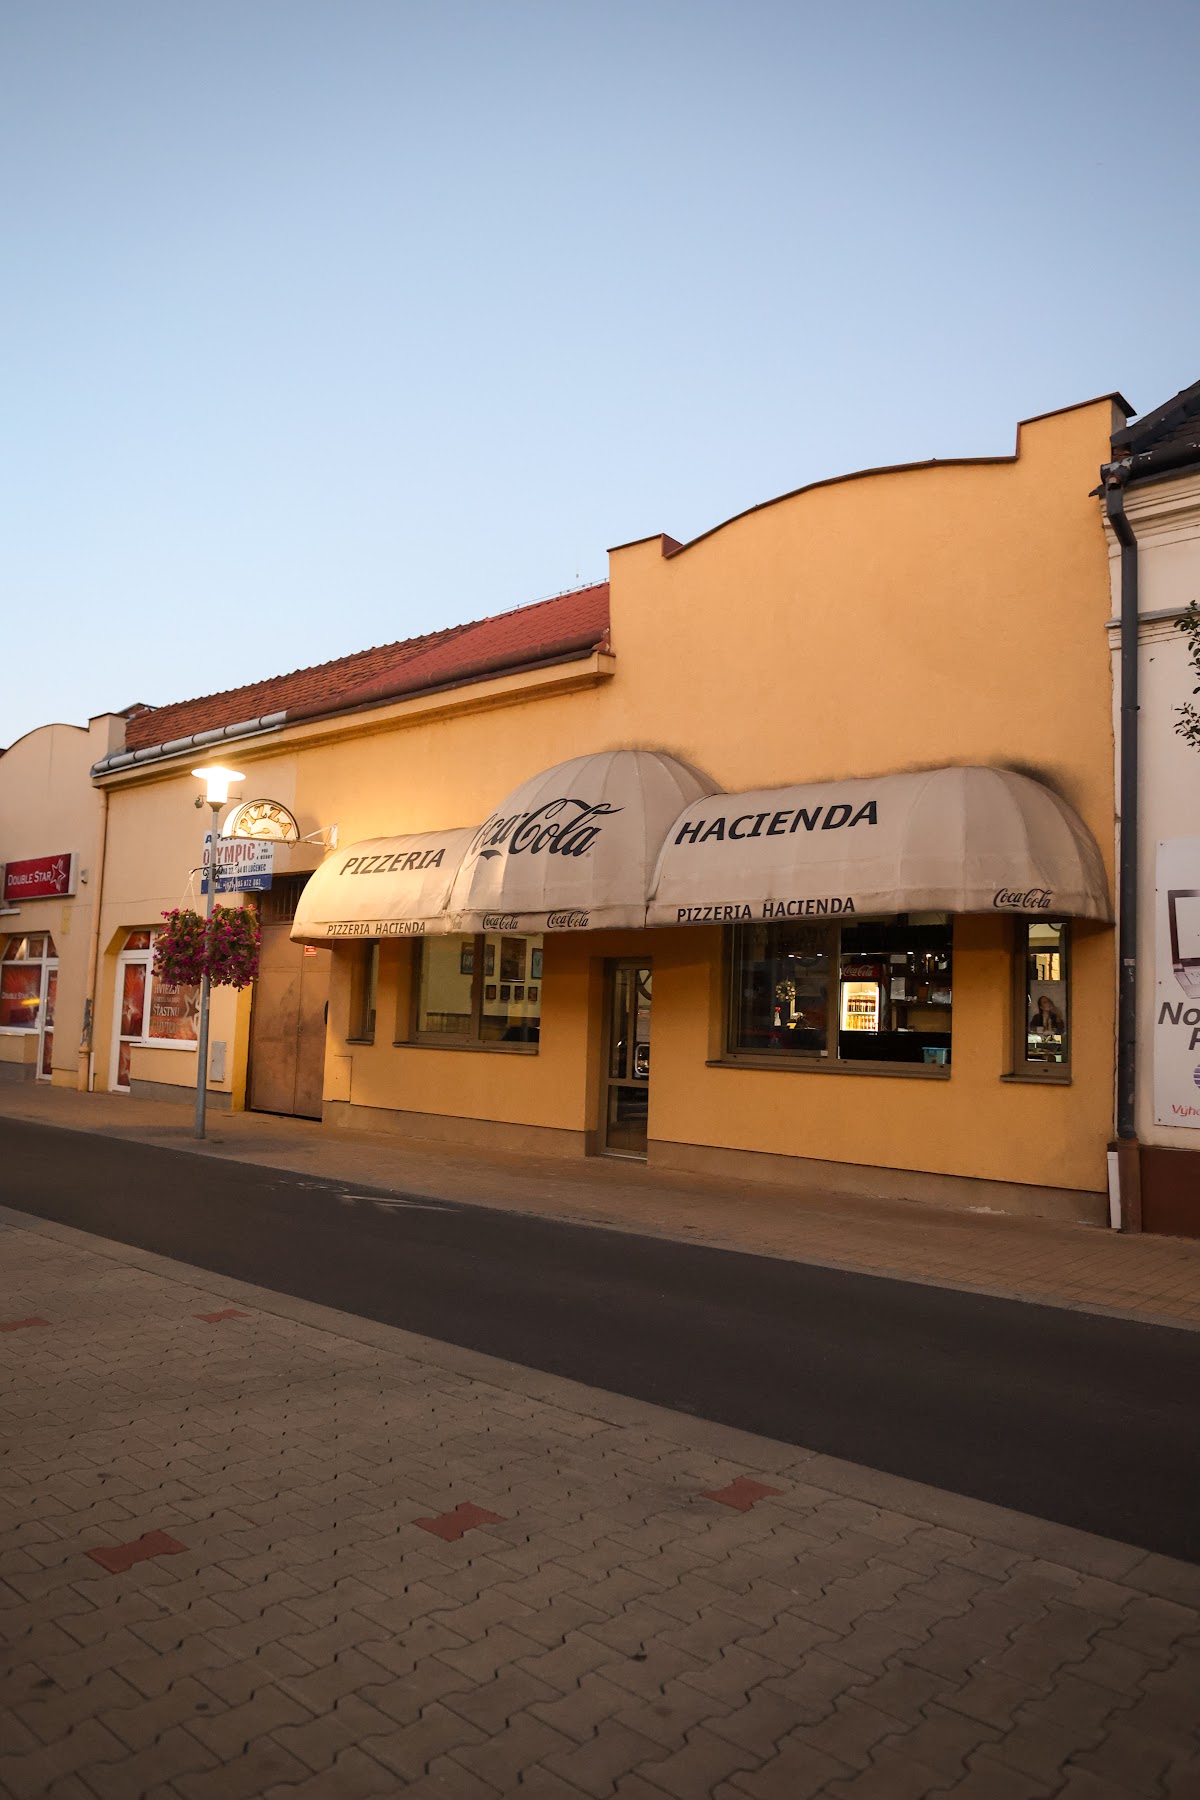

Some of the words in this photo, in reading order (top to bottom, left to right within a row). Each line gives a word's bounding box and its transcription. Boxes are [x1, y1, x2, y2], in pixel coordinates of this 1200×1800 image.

[238, 804, 292, 839] PIZZA
[674, 800, 878, 845] HACIENDA
[203, 842, 255, 866] OYMPIC
[339, 848, 446, 876] PIZZERIA
[677, 904, 752, 923] PIZZERIA
[762, 897, 856, 918] HACIENDA
[993, 888, 1053, 909] Coca-Cola
[327, 923, 370, 936] PIZZERIA
[375, 921, 426, 934] HACIENDA
[546, 910, 591, 929] Coca-Cola
